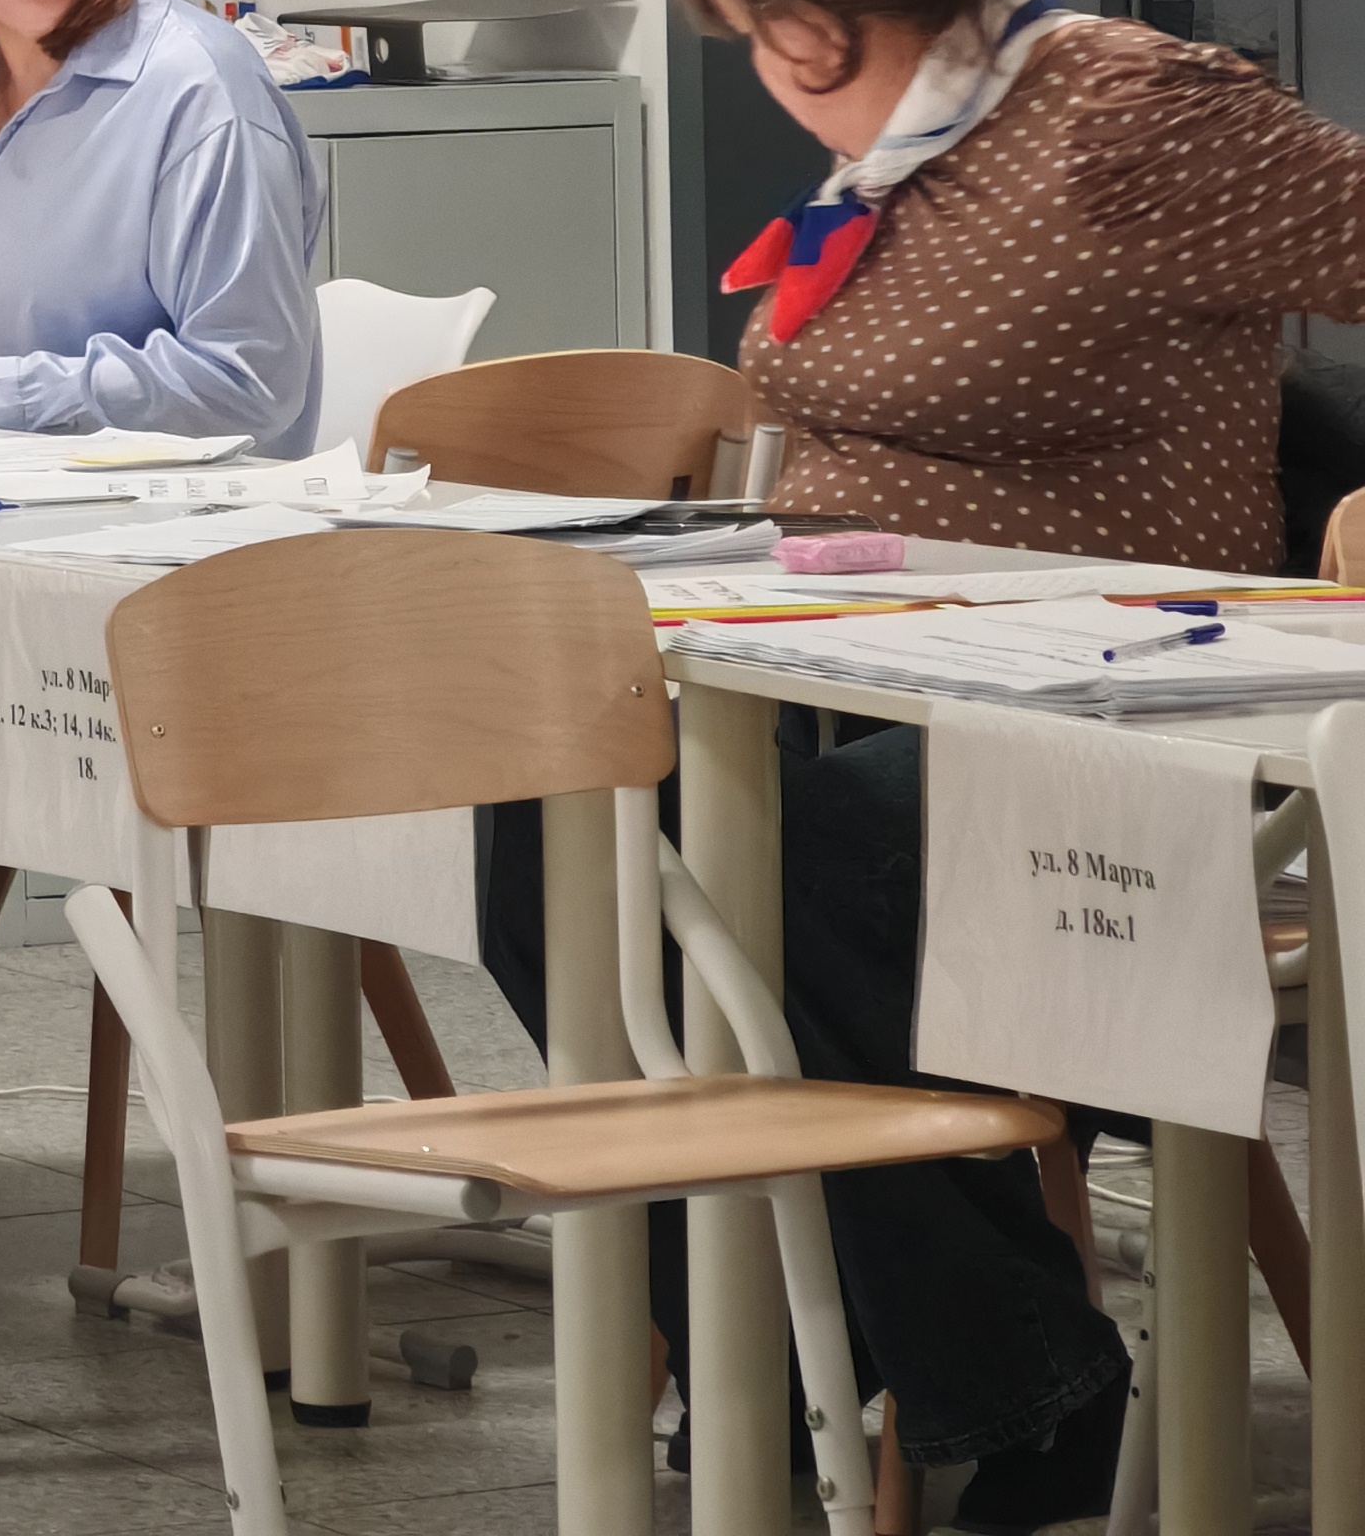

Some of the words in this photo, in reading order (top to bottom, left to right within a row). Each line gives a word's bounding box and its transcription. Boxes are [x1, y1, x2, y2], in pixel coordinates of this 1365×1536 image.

[41, 669, 63, 692] ул.
[66, 667, 74, 690] 8
[79, 669, 110, 703] Мар
[10, 703, 26, 726] 12
[63, 712, 83, 741] 14,
[77, 756, 98, 782] 18.
[1029, 849, 1062, 877] ул.
[1067, 848, 1079, 876] 8
[1084, 850, 1157, 893] Марта
[1055, 909, 1074, 932] д.
